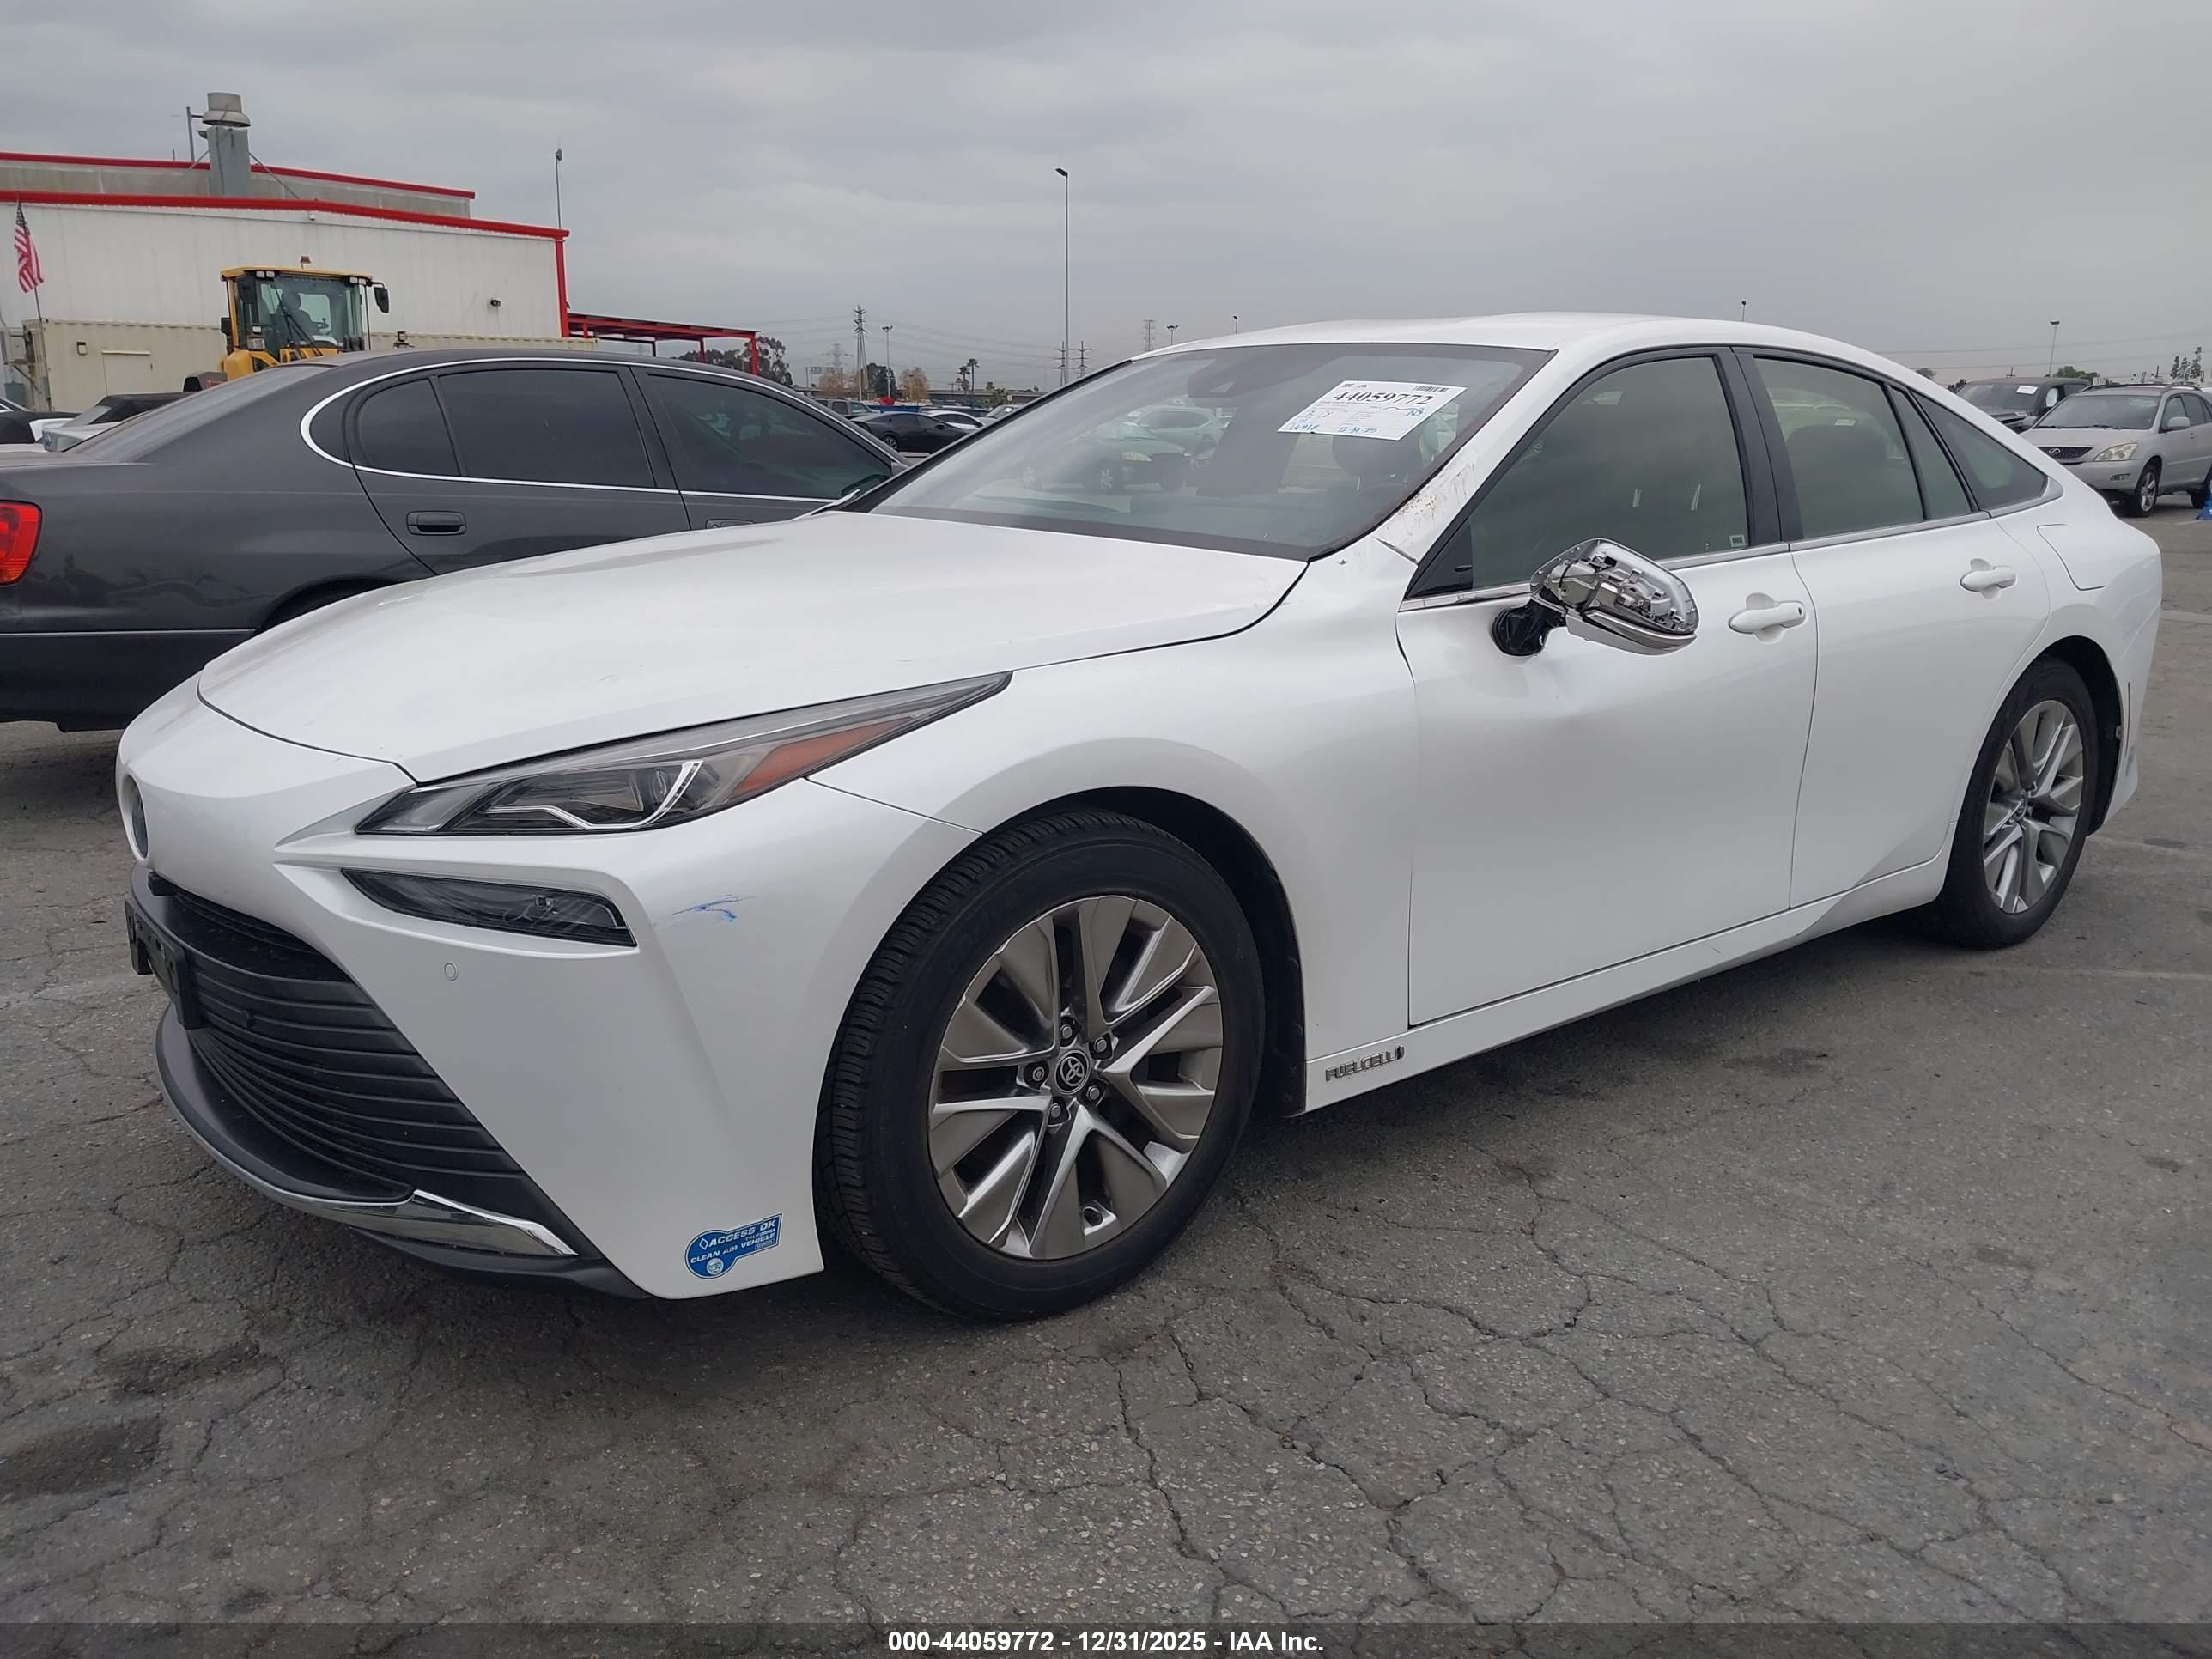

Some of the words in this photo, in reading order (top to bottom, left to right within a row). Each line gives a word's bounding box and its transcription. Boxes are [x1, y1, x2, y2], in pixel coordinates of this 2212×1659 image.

[1333, 391, 1434, 404] 44059772
[708, 1227, 756, 1247] ACCESS
[759, 1219, 776, 1231] OK
[690, 1250, 720, 1264] CLEAN
[723, 1244, 738, 1255] AIR
[741, 1232, 775, 1249] VEHICLE
